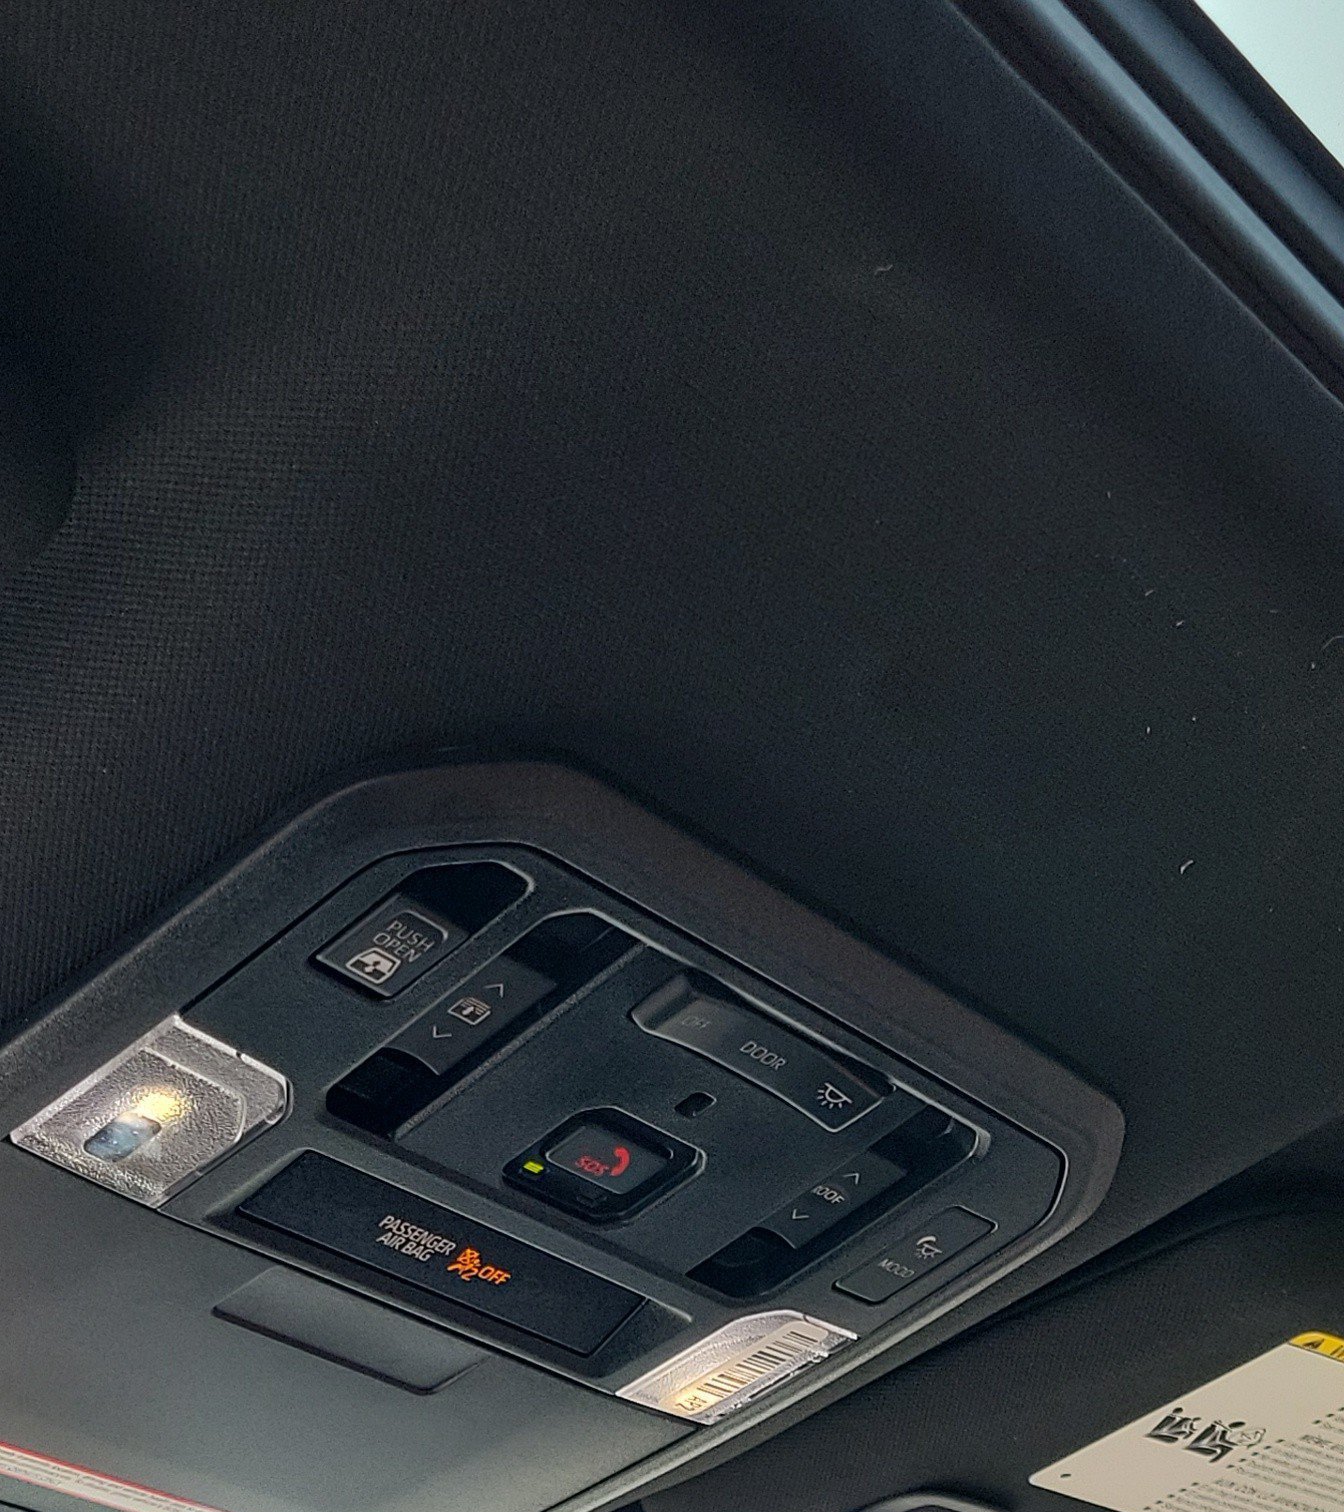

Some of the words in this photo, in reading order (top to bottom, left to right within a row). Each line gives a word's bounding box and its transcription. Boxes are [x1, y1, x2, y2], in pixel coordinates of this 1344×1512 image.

[373, 932, 422, 963] OPEN
[386, 920, 435, 952] PUSH
[739, 1041, 786, 1071] DOOR
[575, 1155, 607, 1177] SOS
[376, 1231, 401, 1250] AIR
[401, 1243, 434, 1263] BAG
[378, 1215, 456, 1256] PASSENGER
[477, 1265, 512, 1286] OFF
